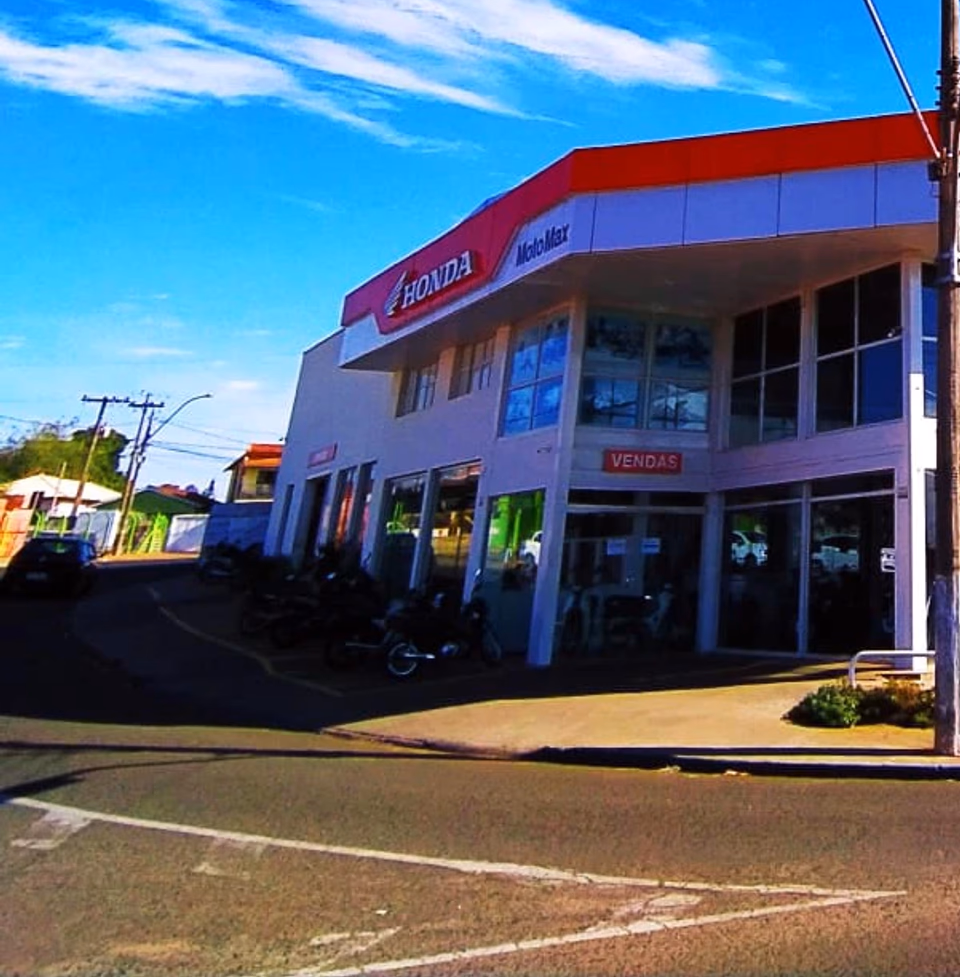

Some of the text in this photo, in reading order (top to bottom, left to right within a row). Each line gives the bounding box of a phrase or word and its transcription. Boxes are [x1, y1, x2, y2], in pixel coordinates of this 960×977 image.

[515, 223, 571, 267] MotoMax
[401, 250, 474, 310] HONDA
[611, 453, 679, 470] VENDAS
